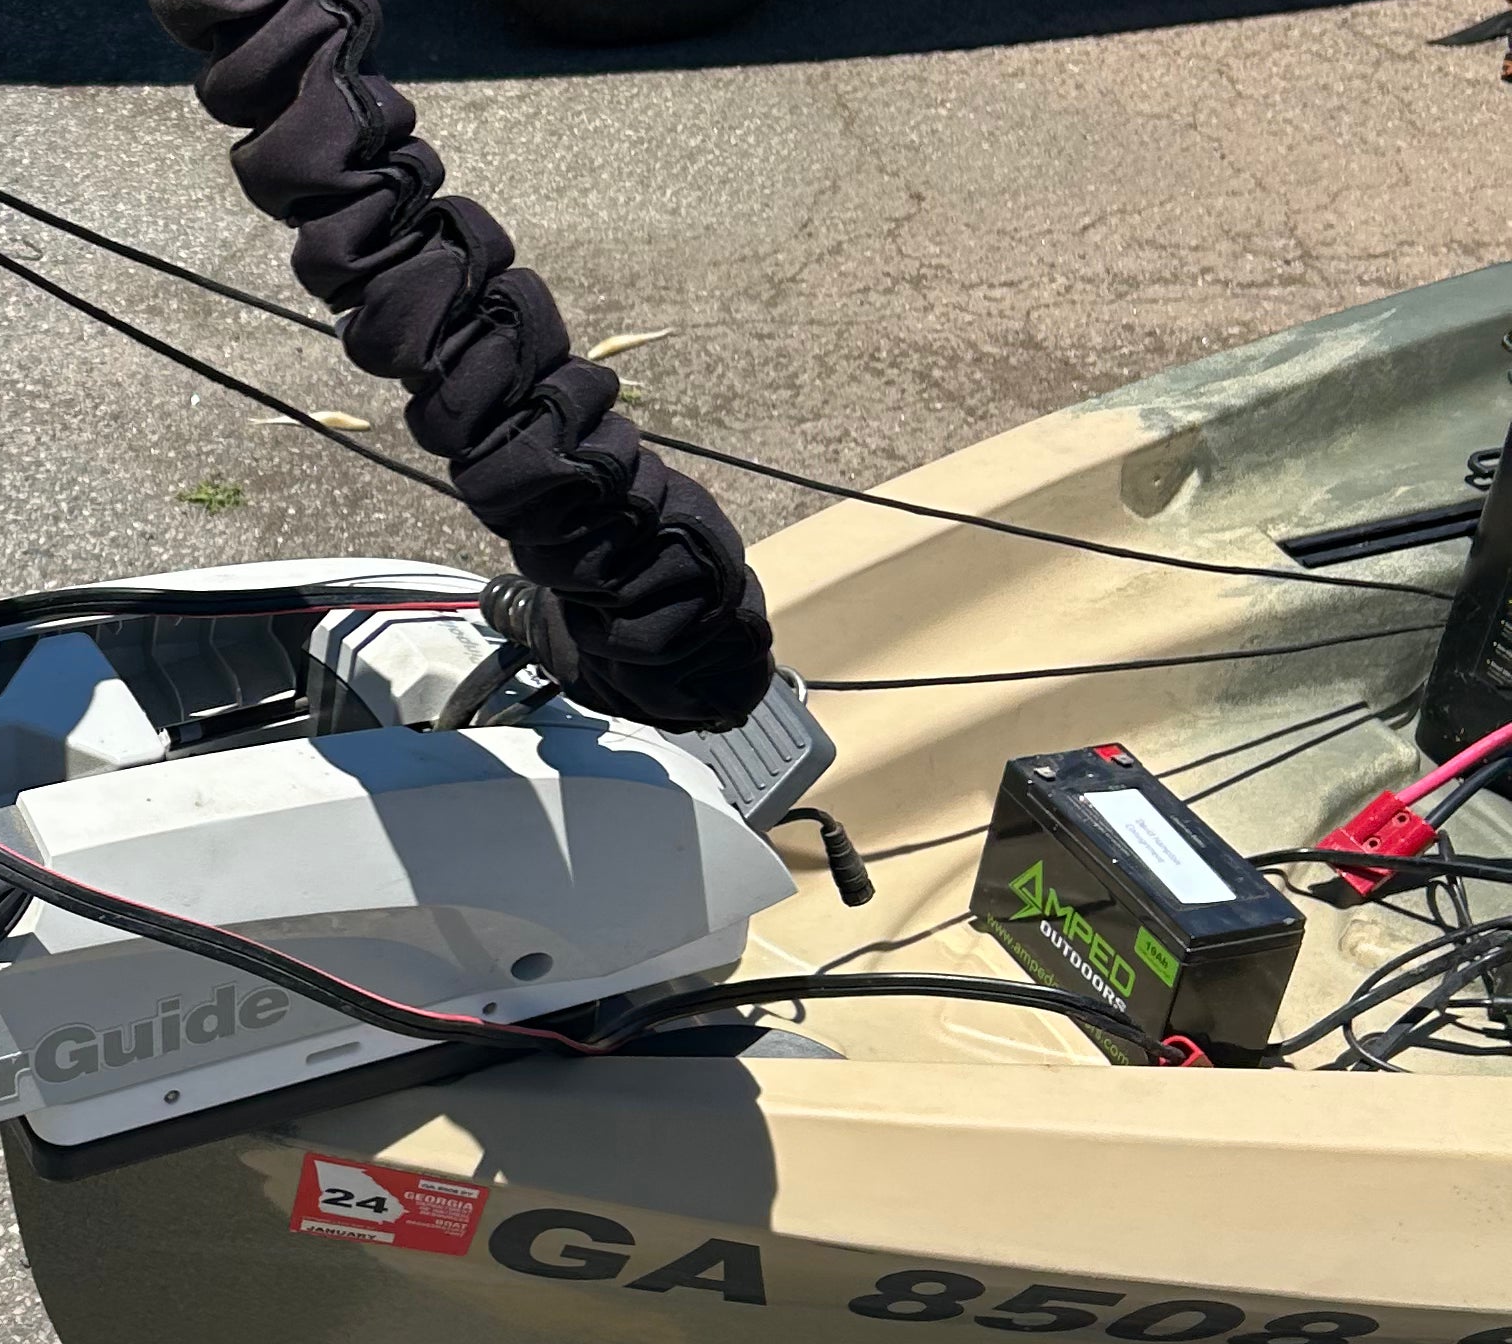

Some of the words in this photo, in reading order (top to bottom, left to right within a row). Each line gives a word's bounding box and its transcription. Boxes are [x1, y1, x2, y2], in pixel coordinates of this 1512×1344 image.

[1008, 860, 1137, 998] AMPED
[1039, 919, 1127, 1013] OUTDOORS
[321, 1188, 388, 1214] 24
[404, 1191, 473, 1211] GEORGIA
[306, 1226, 378, 1241] JANUARY
[489, 1208, 767, 1306] GA
